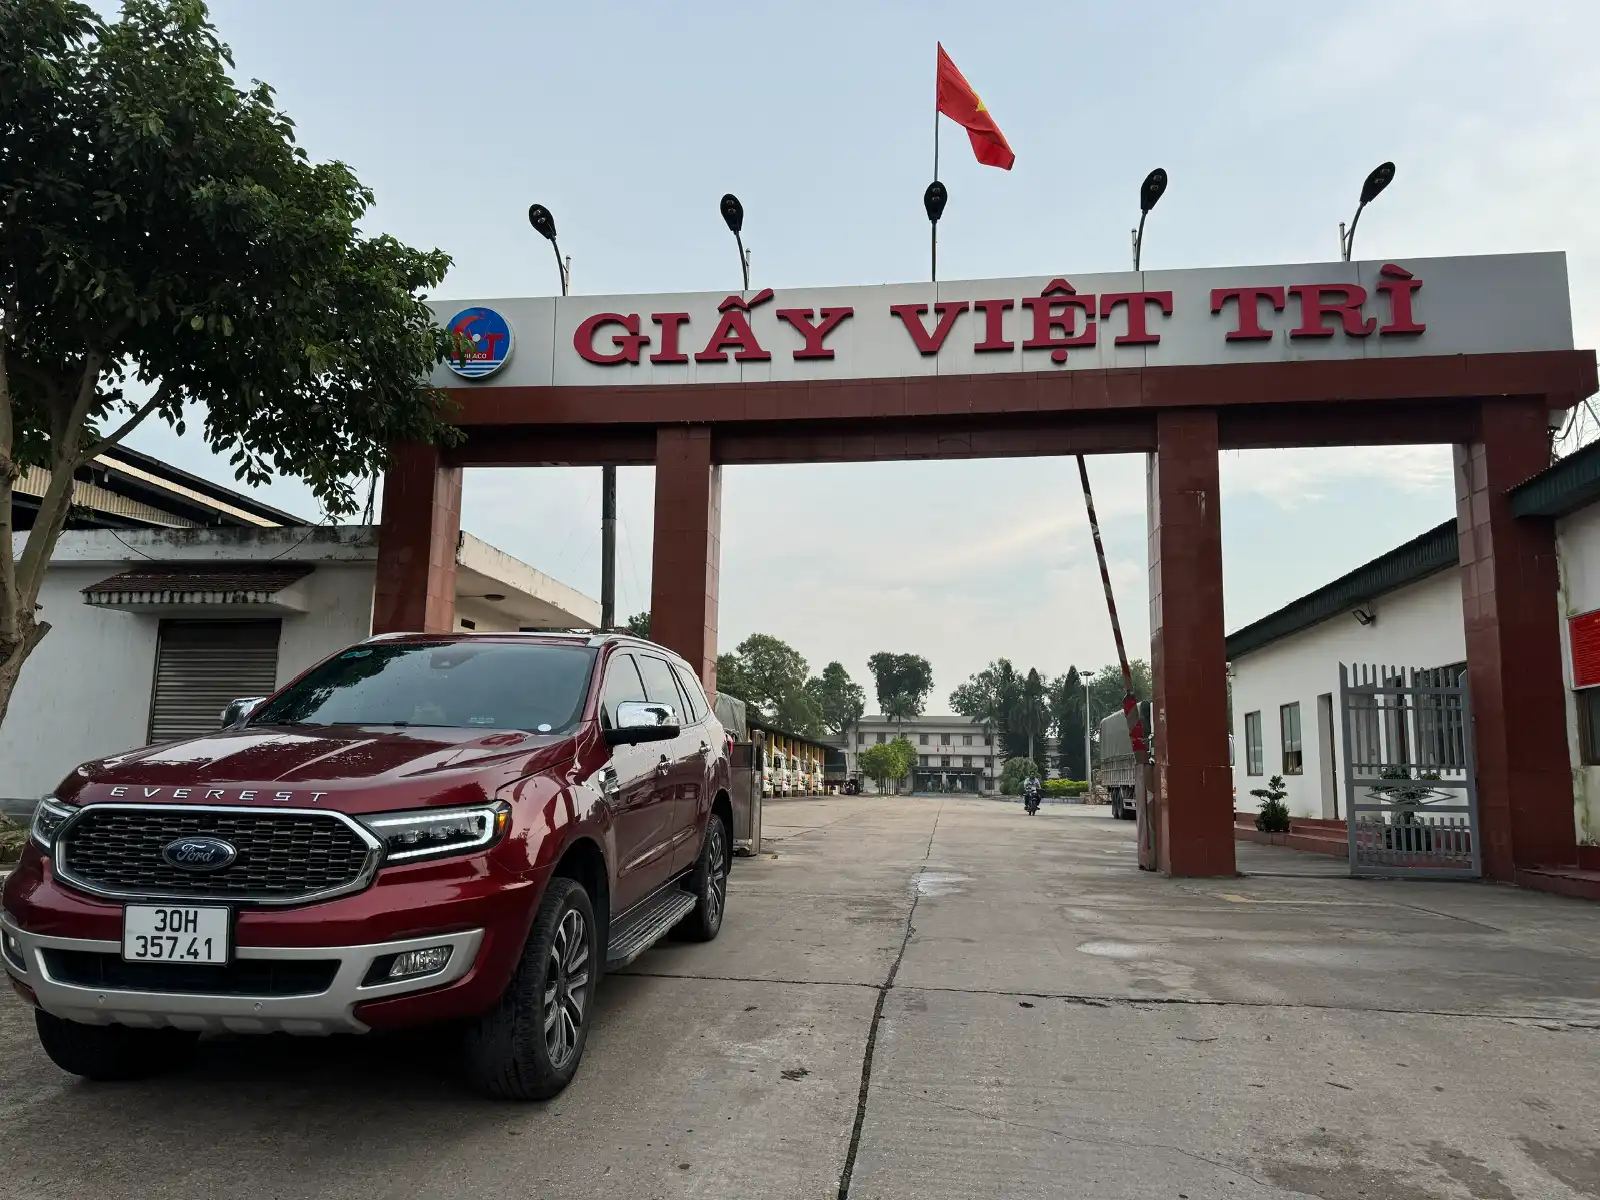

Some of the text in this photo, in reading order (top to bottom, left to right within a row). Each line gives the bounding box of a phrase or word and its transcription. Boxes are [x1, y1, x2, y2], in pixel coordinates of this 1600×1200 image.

[573, 288, 853, 365] GIẤY
[889, 278, 1173, 363] VIỆT
[1210, 264, 1426, 341] TRÌ
[110, 787, 328, 802] EVEREST
[176, 844, 215, 862] Ford
[154, 909, 198, 933] 30H
[135, 936, 212, 959] 357.41
